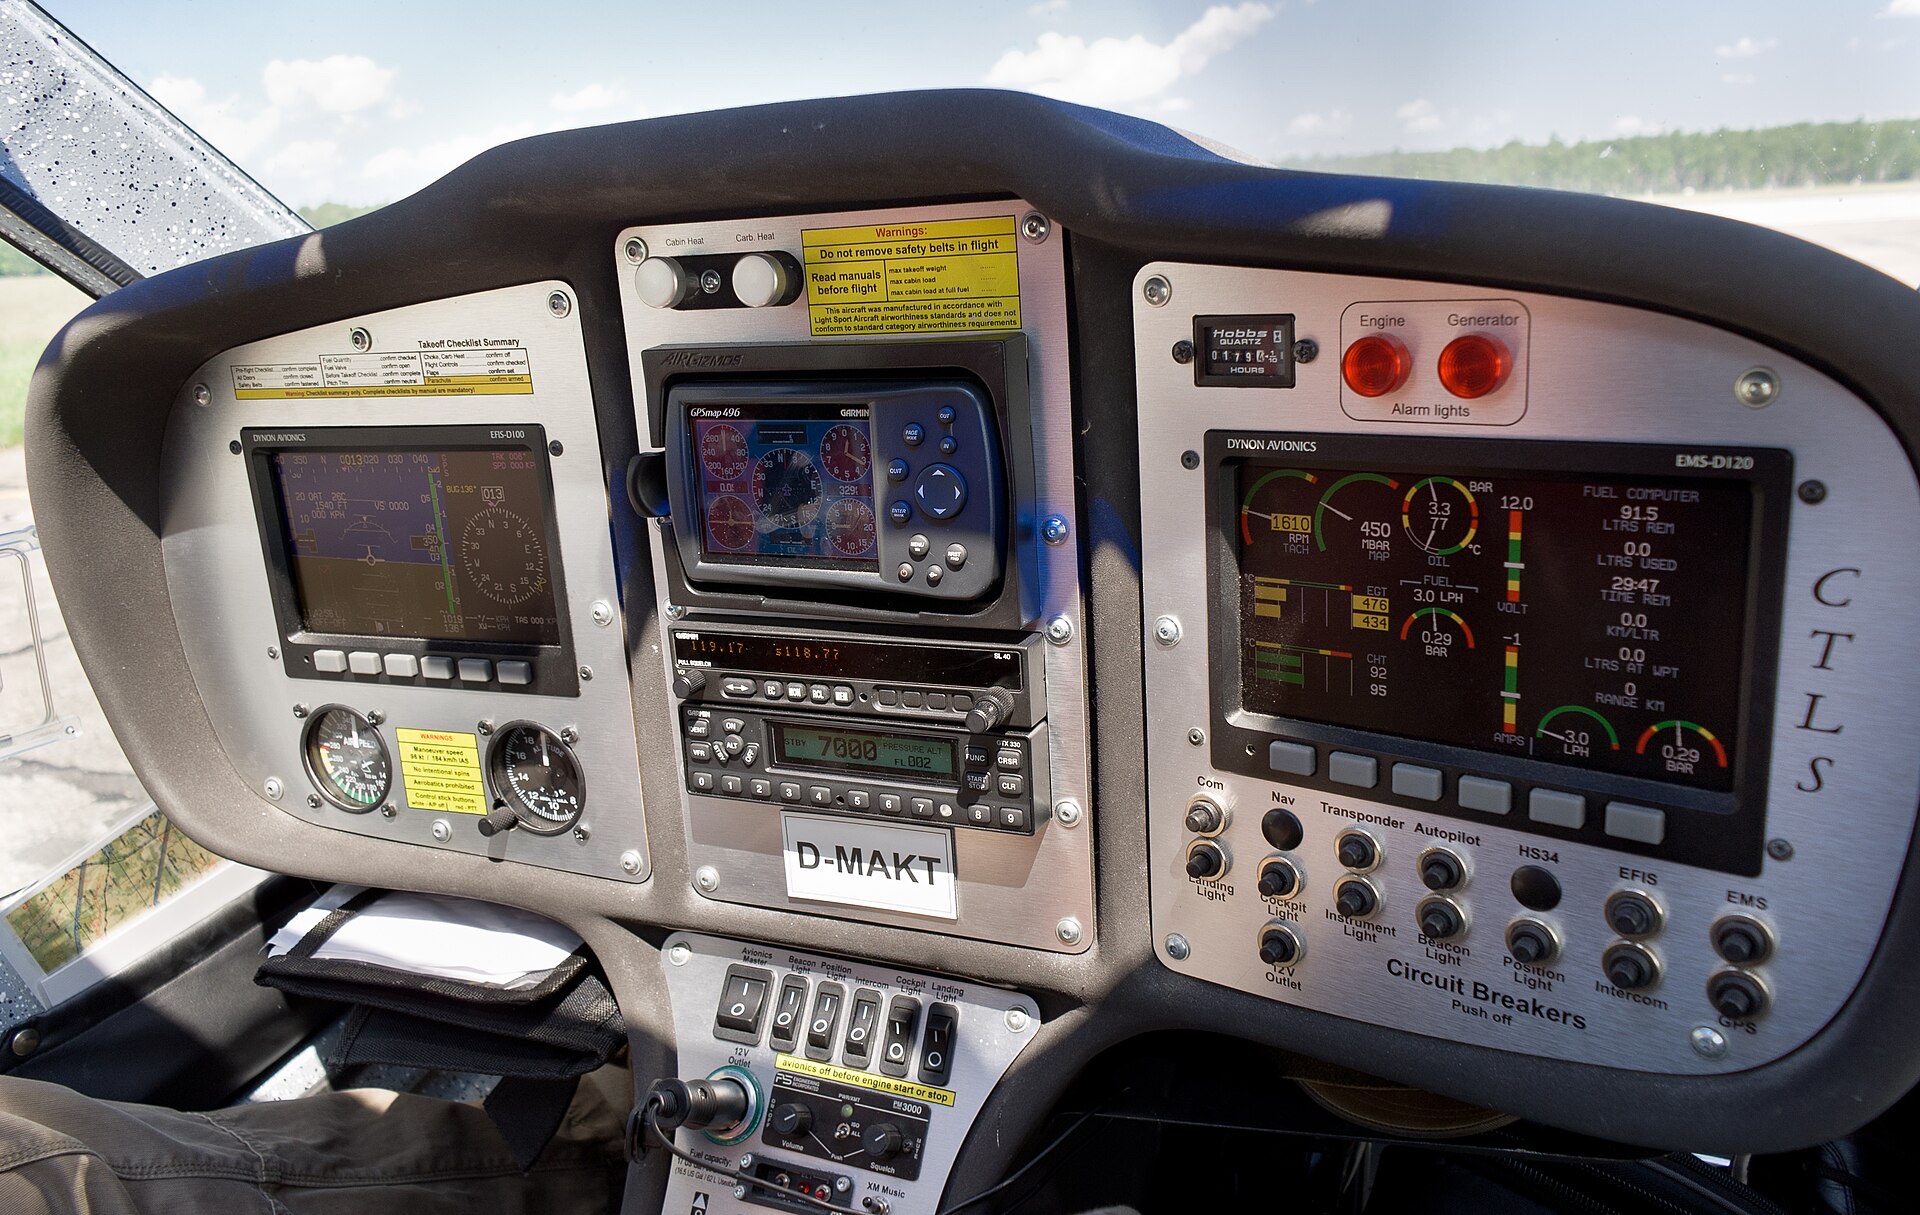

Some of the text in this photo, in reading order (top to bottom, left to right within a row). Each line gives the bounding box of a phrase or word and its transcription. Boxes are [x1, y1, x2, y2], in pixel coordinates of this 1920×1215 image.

[736, 232, 775, 242] Carb. Heat
[876, 227, 928, 238] Warnings:
[666, 238, 685, 246] Cabin
[820, 240, 998, 259] Do not remove safety belts in flight
[812, 270, 881, 282] Read manuals
[818, 284, 877, 295] before flight
[884, 303, 932, 312] manufactured
[930, 311, 966, 319] standards
[1448, 314, 1519, 327] Generator
[1360, 315, 1405, 329] Engine
[1213, 329, 1267, 338] Hobbs
[418, 338, 519, 348] Takeoff Checklist Summary
[691, 408, 740, 418] GPSmap 496
[841, 409, 869, 417] GARMIN
[1392, 403, 1470, 418] Alarm lights
[253, 434, 305, 442] DYNON AVIONICS
[490, 430, 524, 439] EFIS-D100
[1227, 439, 1316, 452] DYNON AVIONICS
[1676, 454, 1754, 469] EMS-D120
[1470, 481, 1493, 493] BAR
[1584, 486, 1699, 502] FUEL COMPUTER
[1429, 503, 1450, 515] 3.3
[1500, 497, 1533, 510] 12.0
[1620, 506, 1658, 521] 91.5
[1273, 515, 1311, 532] 1610
[1361, 522, 1391, 537] 450
[1430, 518, 1448, 530] 77
[1289, 533, 1309, 544] RPM
[1362, 539, 1390, 550] MBAR
[1284, 543, 1309, 554] TACH
[1369, 551, 1390, 561] MAP
[1428, 556, 1449, 567] OIL
[1597, 555, 1677, 571] LTRS USED
[1367, 586, 1388, 596] EGT
[1612, 577, 1659, 593] 29:47
[1363, 598, 1387, 610] 476
[1497, 602, 1528, 614] VOLT
[1363, 616, 1387, 629] 434
[1607, 625, 1659, 641] KM/LTR
[692, 641, 743, 653] 119.17
[1370, 667, 1387, 679] 92
[1796, 568, 1861, 792] CTLS
[768, 686, 775, 695] EC
[813, 690, 824, 699] RCL
[1494, 733, 1525, 746] AMPS
[818, 736, 877, 761] 7000
[884, 743, 924, 753] PRESSURE
[908, 756, 931, 769] 002
[966, 754, 985, 762] FUNC
[998, 757, 1018, 765] CRSR
[518, 773, 529, 781] 14
[1197, 776, 1224, 790] Com
[446, 782, 474, 790] prohibited
[1272, 791, 1295, 805] Nav
[1321, 802, 1405, 829] Transponder
[1414, 823, 1480, 846] Autopilot
[1519, 845, 1559, 864] HS34
[797, 840, 941, 886] D-MAKT
[1619, 867, 1658, 885] EFIS
[1727, 890, 1768, 910] EMS
[1344, 925, 1377, 943] Light
[1418, 934, 1470, 956] Beacon
[742, 947, 772, 959] Avionics
[1426, 947, 1462, 966] Light
[743, 956, 768, 966] Master
[789, 956, 816, 968] Beacon
[791, 965, 810, 975] Light
[821, 962, 852, 975] Position
[827, 972, 846, 982] Light
[856, 977, 889, 989] Intercom
[896, 976, 926, 989] Cockpit
[1266, 974, 1302, 991] Outlet
[901, 985, 921, 995] Light
[932, 982, 964, 997] Landing
[1387, 959, 1587, 1030] Circuit Breakers
[1595, 981, 1669, 1010] Intercom
[936, 992, 957, 1003] Light
[1453, 1000, 1512, 1026] Push off
[735, 1048, 749, 1056] 12V
[728, 1057, 750, 1067] Outlet
[783, 1060, 948, 1103] avionics off before engine start or stop
[782, 1140, 803, 1151] Volume
[690, 1148, 731, 1167] Fuel capacity:
[870, 1162, 895, 1174] Squelch
[867, 1182, 905, 1199] XM Music
